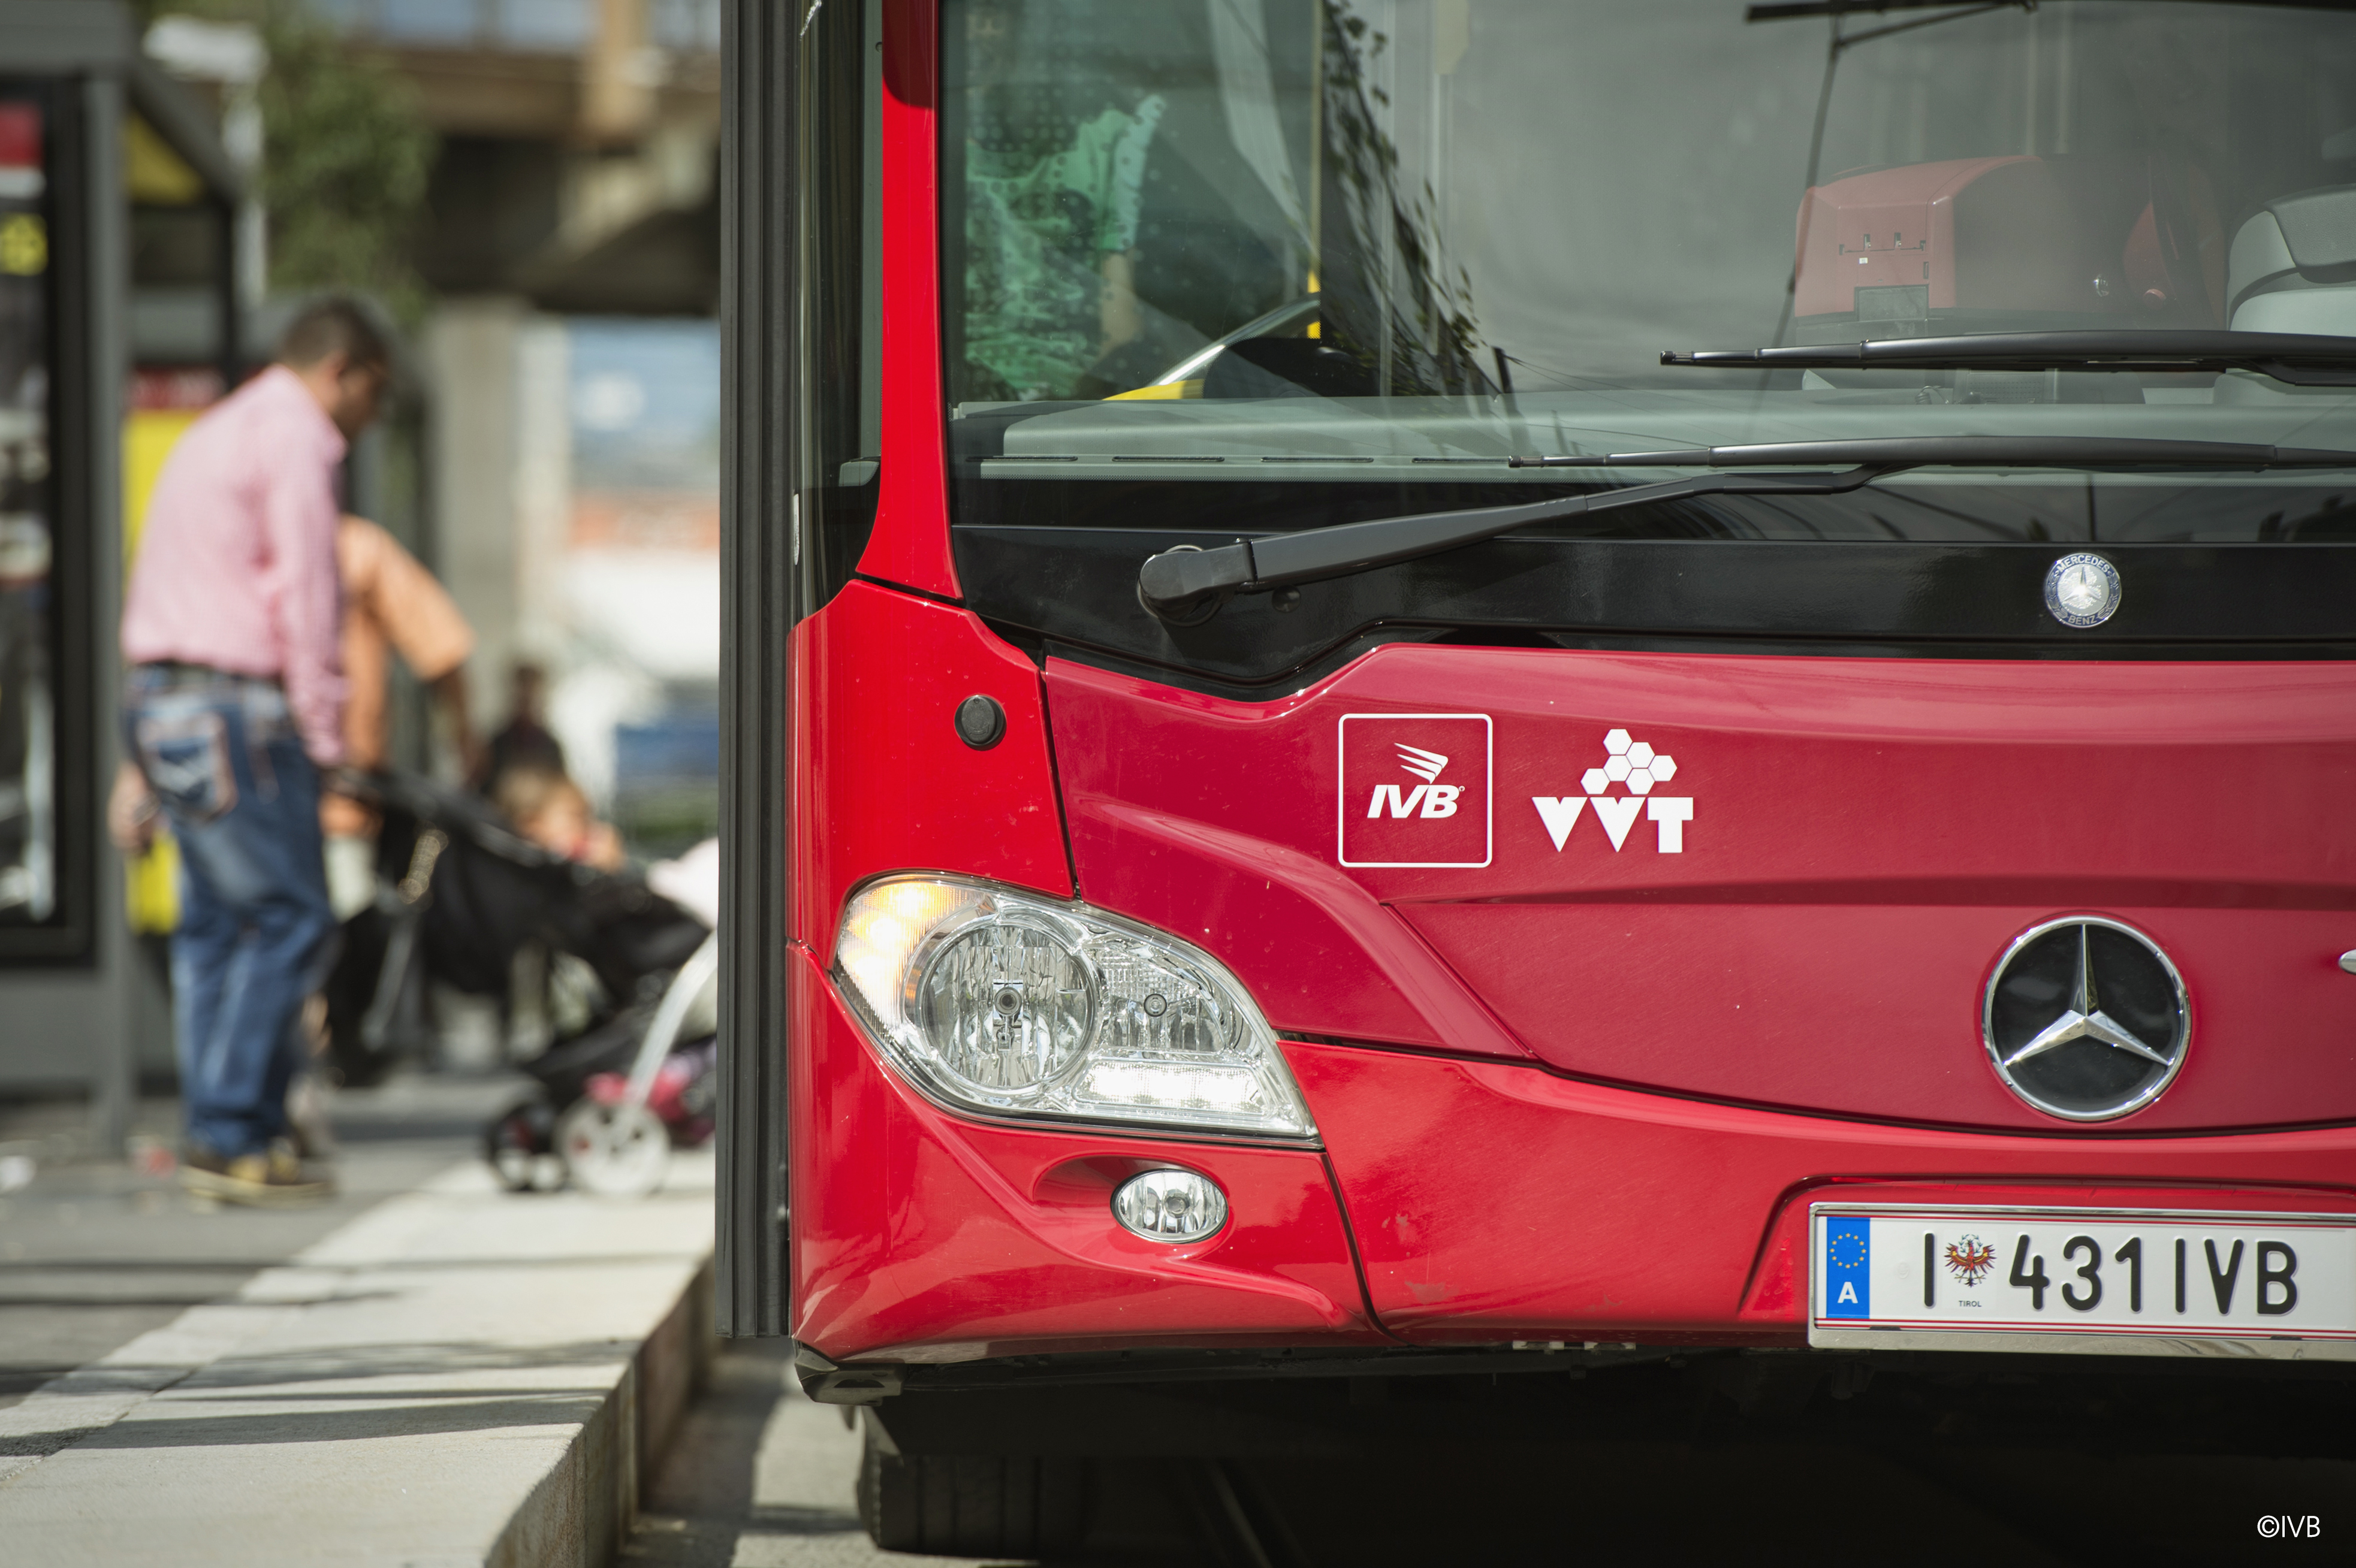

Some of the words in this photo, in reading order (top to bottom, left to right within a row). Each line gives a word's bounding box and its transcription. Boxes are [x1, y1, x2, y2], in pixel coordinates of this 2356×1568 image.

[2056, 554, 2110, 573] MERCEDES
[2068, 615, 2098, 625] BENZ
[1532, 796, 1694, 853] VVT
[1924, 1233, 1934, 1307] I
[2009, 1235, 2141, 1312] 431
[2176, 1238, 2297, 1315] IVB
[1838, 1282, 1858, 1304] A
